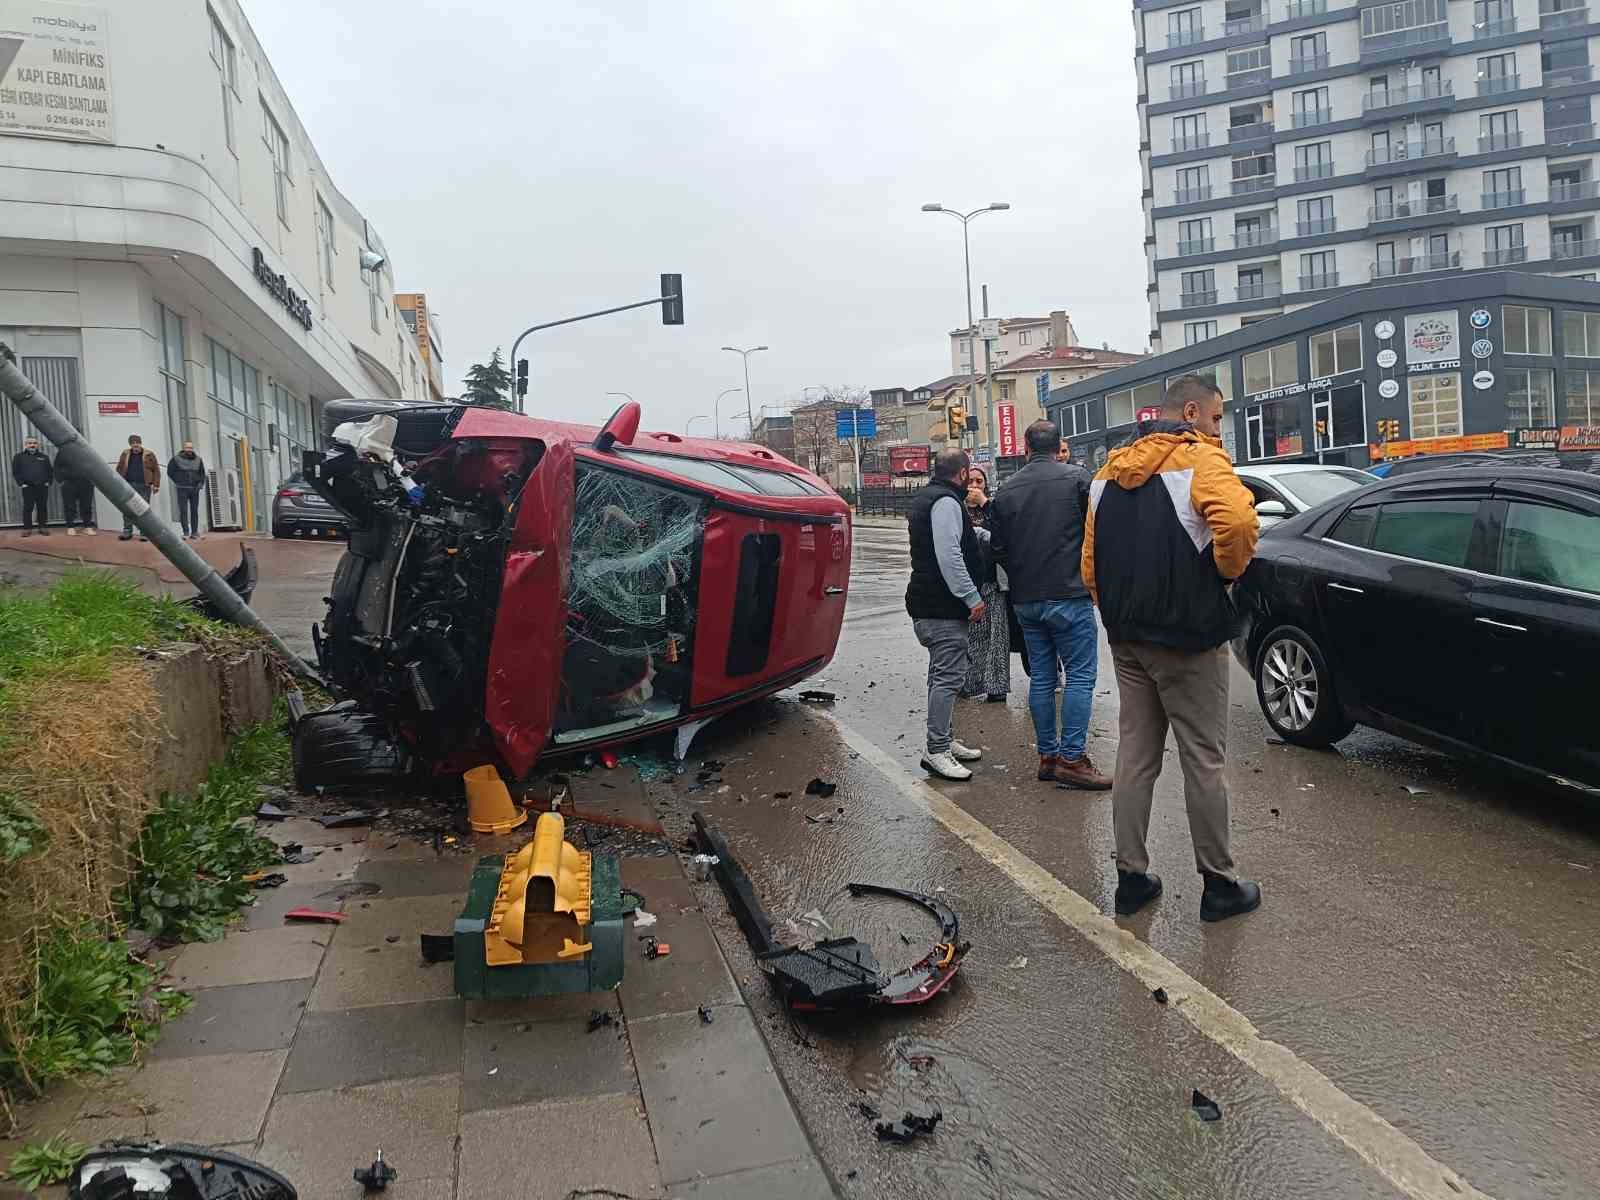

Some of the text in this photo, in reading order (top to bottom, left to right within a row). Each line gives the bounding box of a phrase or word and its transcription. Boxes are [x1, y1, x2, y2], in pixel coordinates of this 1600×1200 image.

[32, 16, 96, 31] mobilya
[17, 68, 106, 91] KAPI EBATLAMA
[68, 97, 108, 114] BANTLAMA
[1439, 360, 1461, 369] OTO
[1270, 389, 1284, 399] OTO
[1307, 378, 1333, 391] PARÇA
[1002, 406, 1013, 455] EGZOZ
